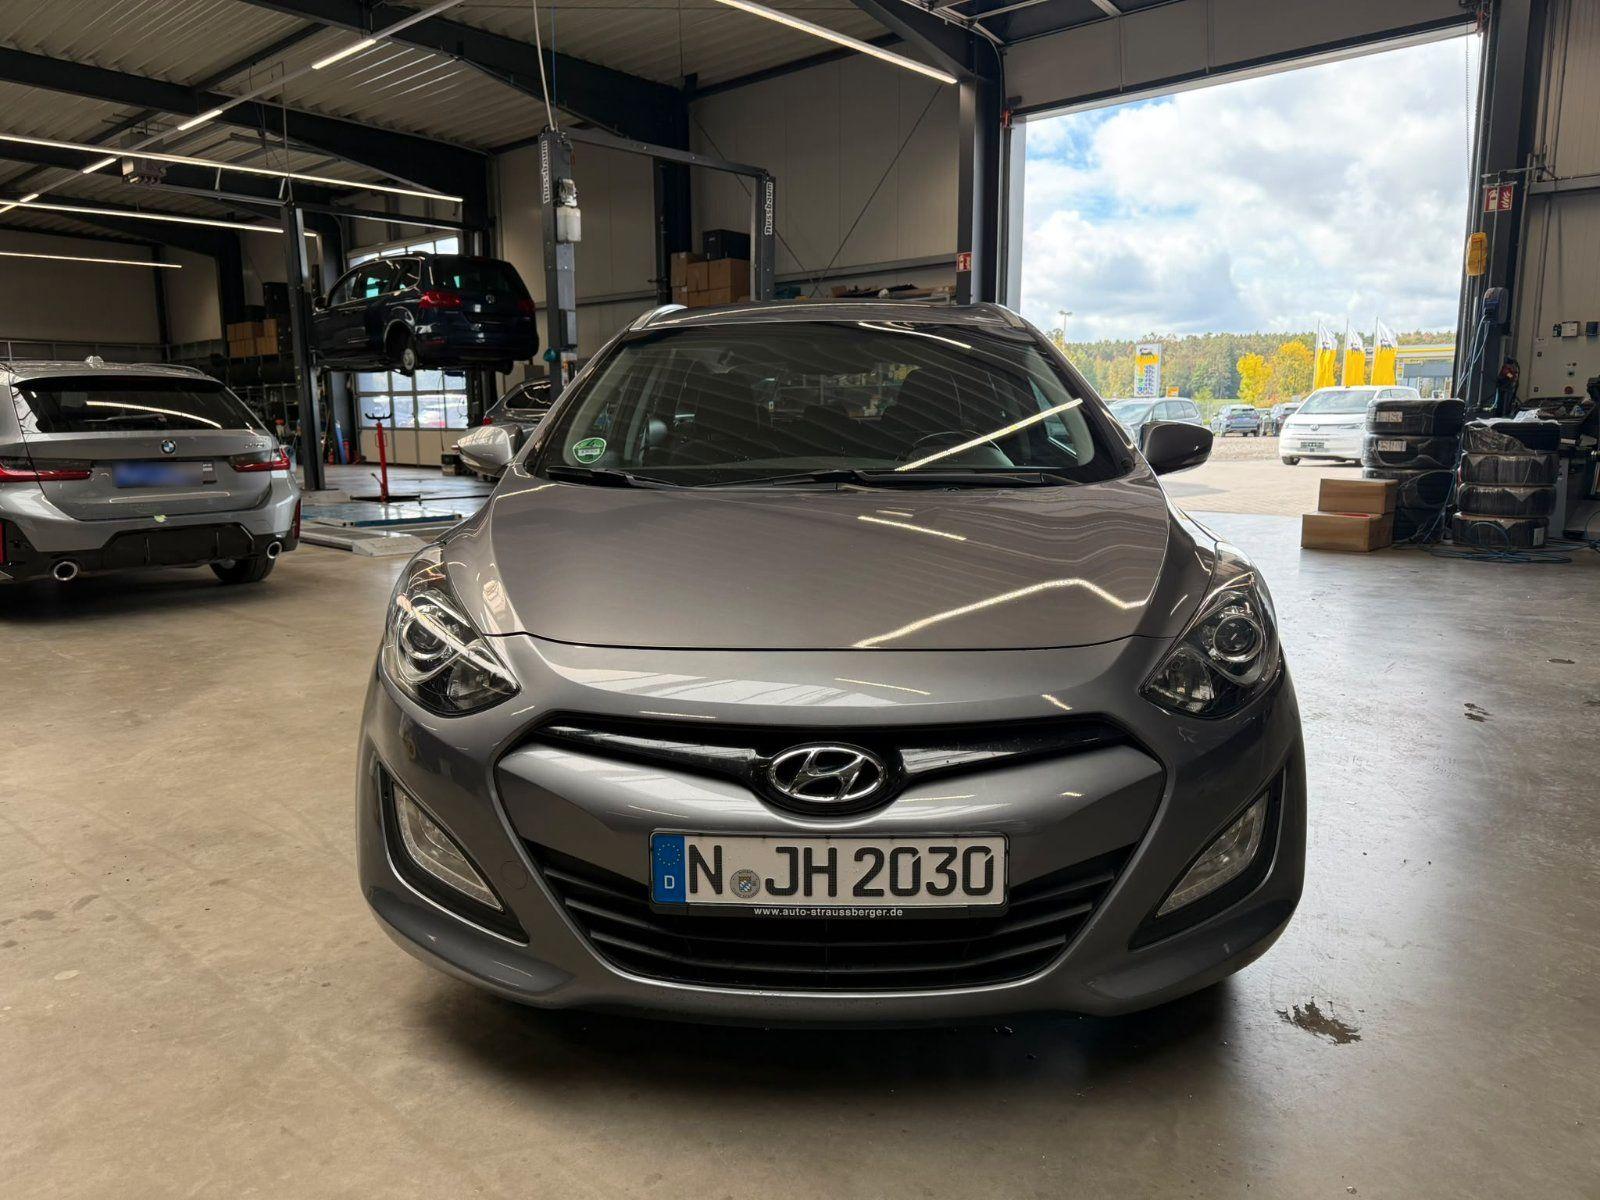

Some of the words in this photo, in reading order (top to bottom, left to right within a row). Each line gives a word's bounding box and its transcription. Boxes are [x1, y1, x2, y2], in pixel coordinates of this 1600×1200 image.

[688, 844, 723, 895] N
[765, 846, 838, 897] JH
[852, 846, 994, 897] 2030
[664, 875, 675, 889] D
[754, 907, 903, 919] www.auto-straussberger.de
